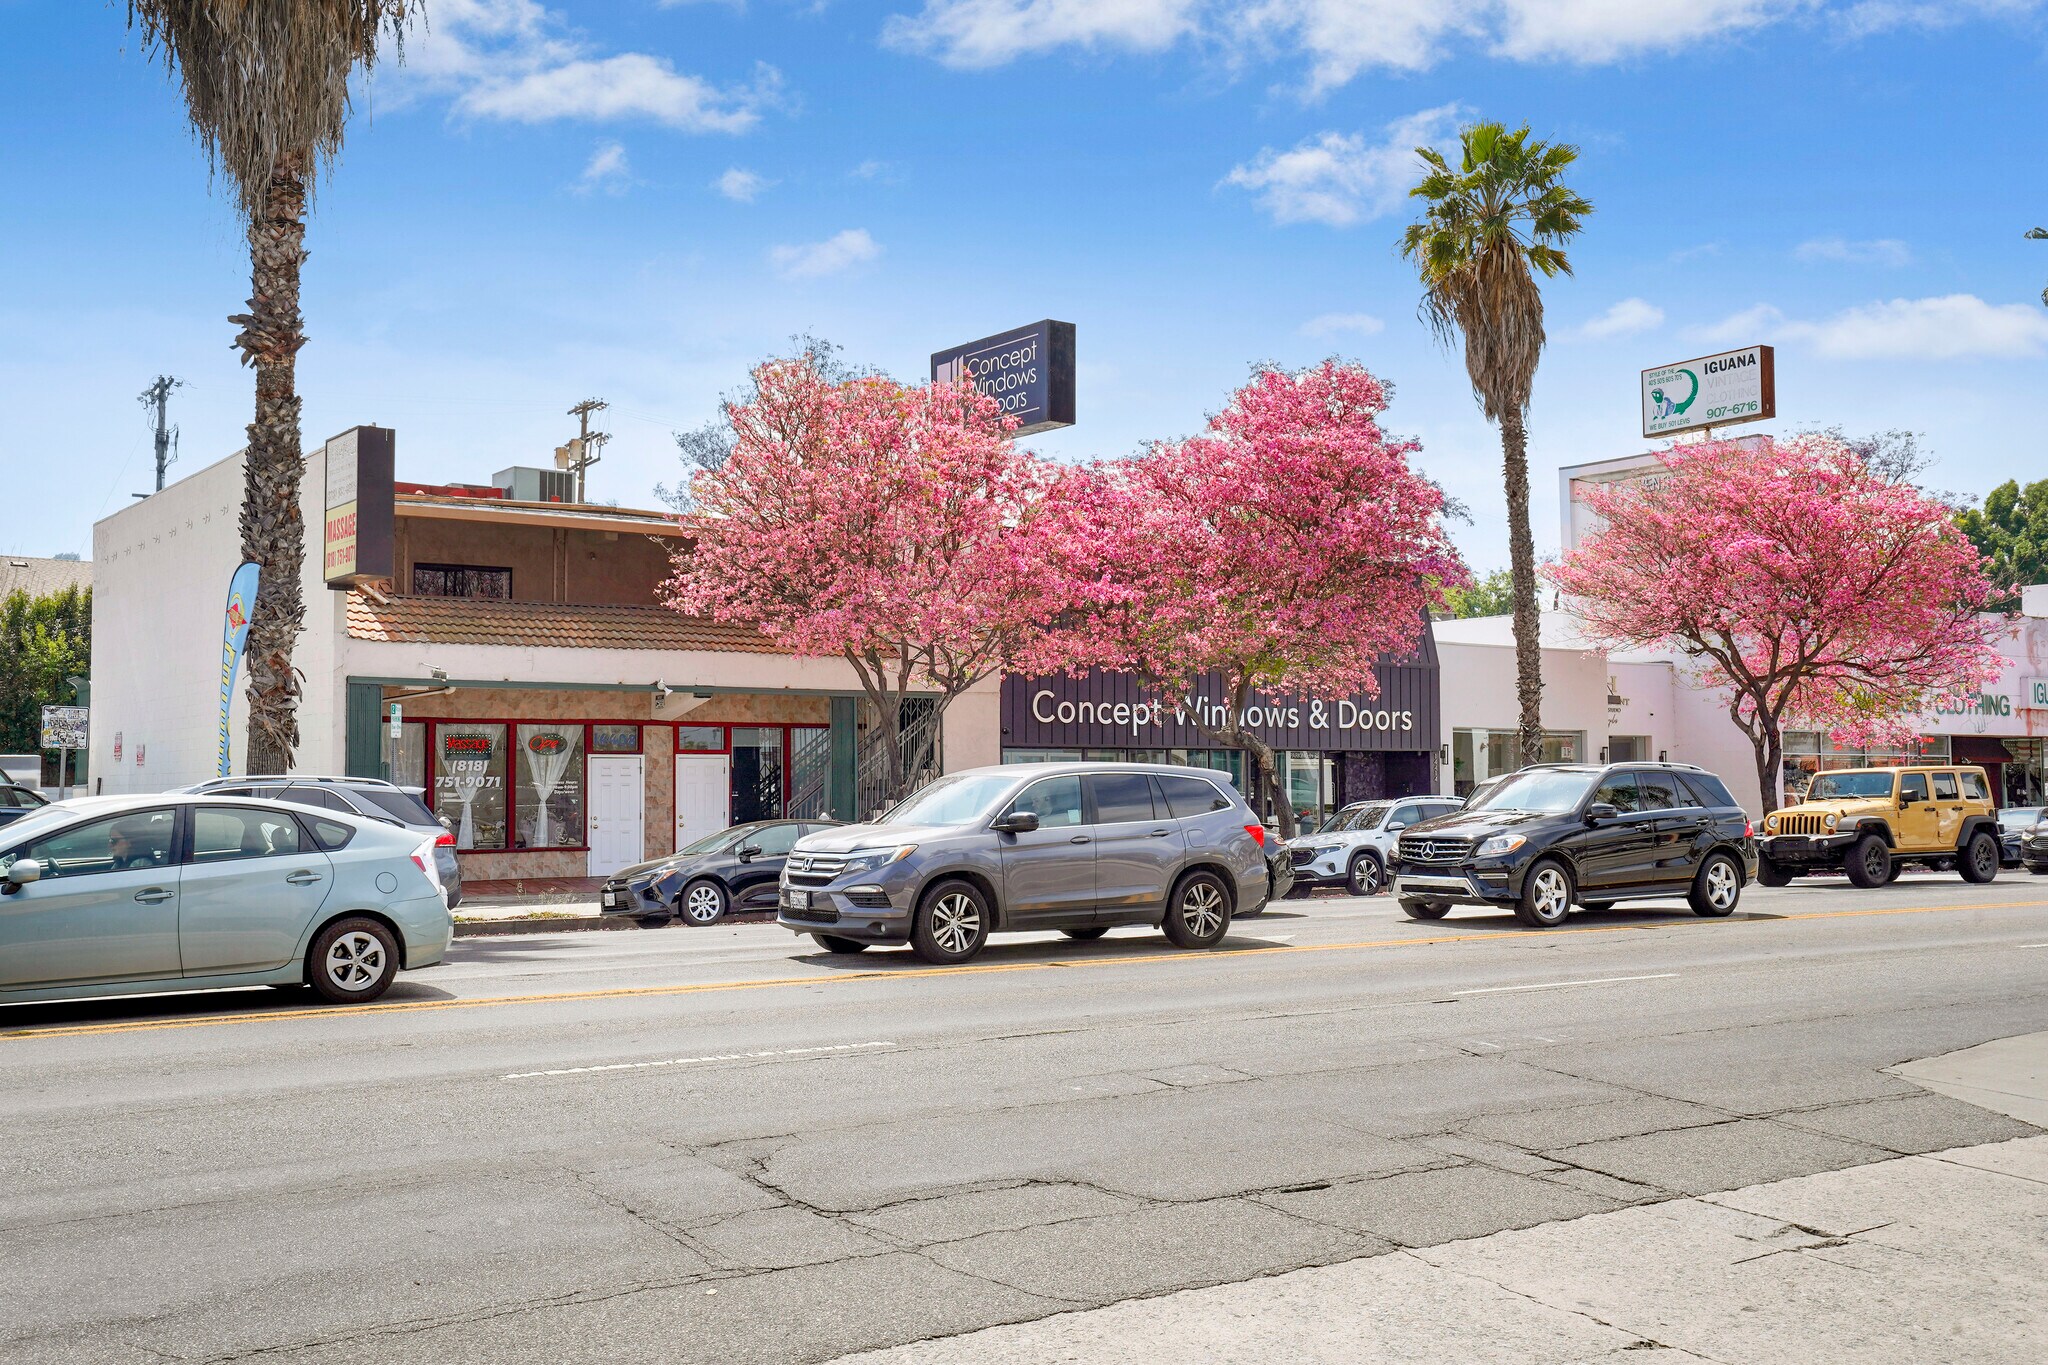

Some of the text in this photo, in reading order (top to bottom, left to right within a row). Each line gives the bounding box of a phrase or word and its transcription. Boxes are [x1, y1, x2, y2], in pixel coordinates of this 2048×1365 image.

[968, 340, 1038, 378] Concept
[1704, 353, 1757, 375] IGUANA
[1649, 371, 1660, 379] STYLE
[1706, 369, 1757, 389] VINTAGE
[996, 391, 1027, 413] oors
[1706, 385, 1758, 405] CLOTHING
[1706, 400, 1758, 419] 907-6716
[1658, 422, 1667, 430] BUY
[1668, 420, 1677, 428] 501
[327, 512, 357, 543] MASSAGE
[327, 544, 356, 569] (818) 751-9071
[1032, 690, 1413, 737] Concept Winows & Doors
[447, 736, 490, 753] Massage
[451, 760, 488, 774] (818)
[435, 776, 501, 788] 751-9071
